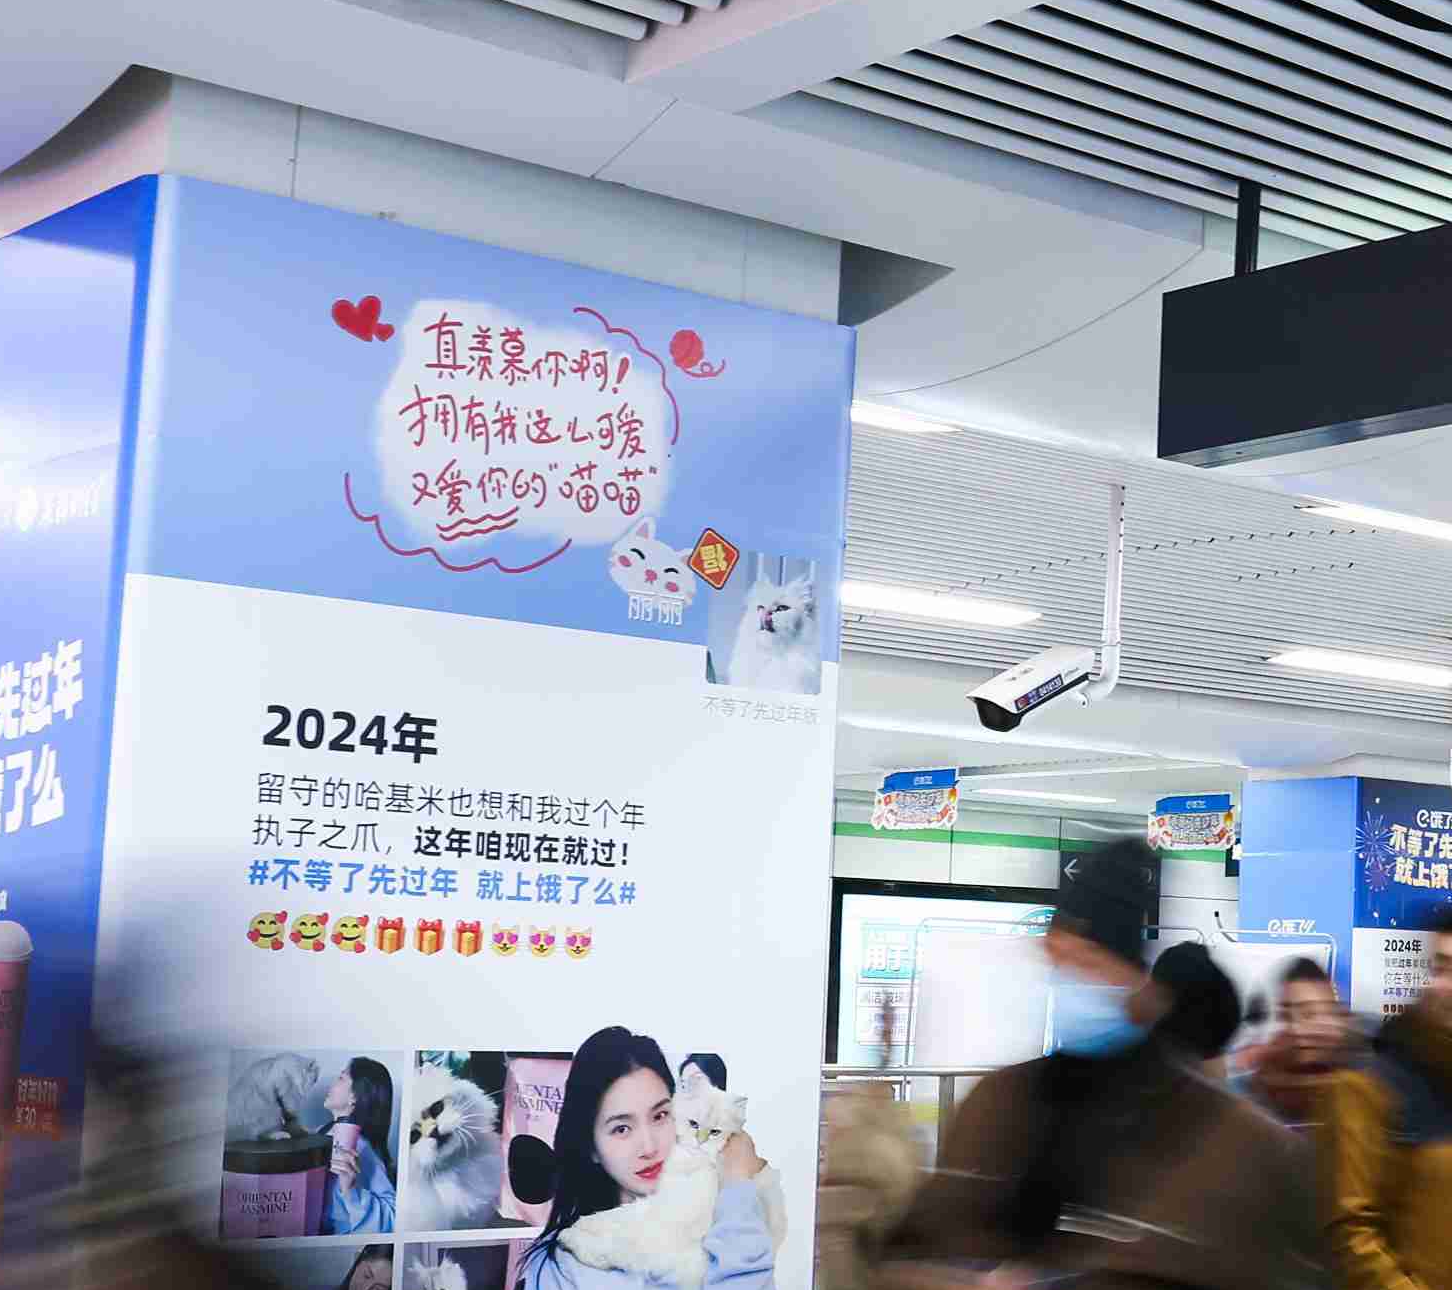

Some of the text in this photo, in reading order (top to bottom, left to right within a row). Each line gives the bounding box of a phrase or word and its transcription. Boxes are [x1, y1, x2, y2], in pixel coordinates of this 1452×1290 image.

[399, 384, 646, 460] 拥有我这么可爱
[628, 590, 685, 626] 丽丽
[262, 704, 439, 764] 2024年
[256, 771, 646, 830] 留守的哈基米也想和我过个年
[248, 857, 637, 906] #不等了先过年 就上饿了么#
[1384, 939, 1422, 954] 2024年
